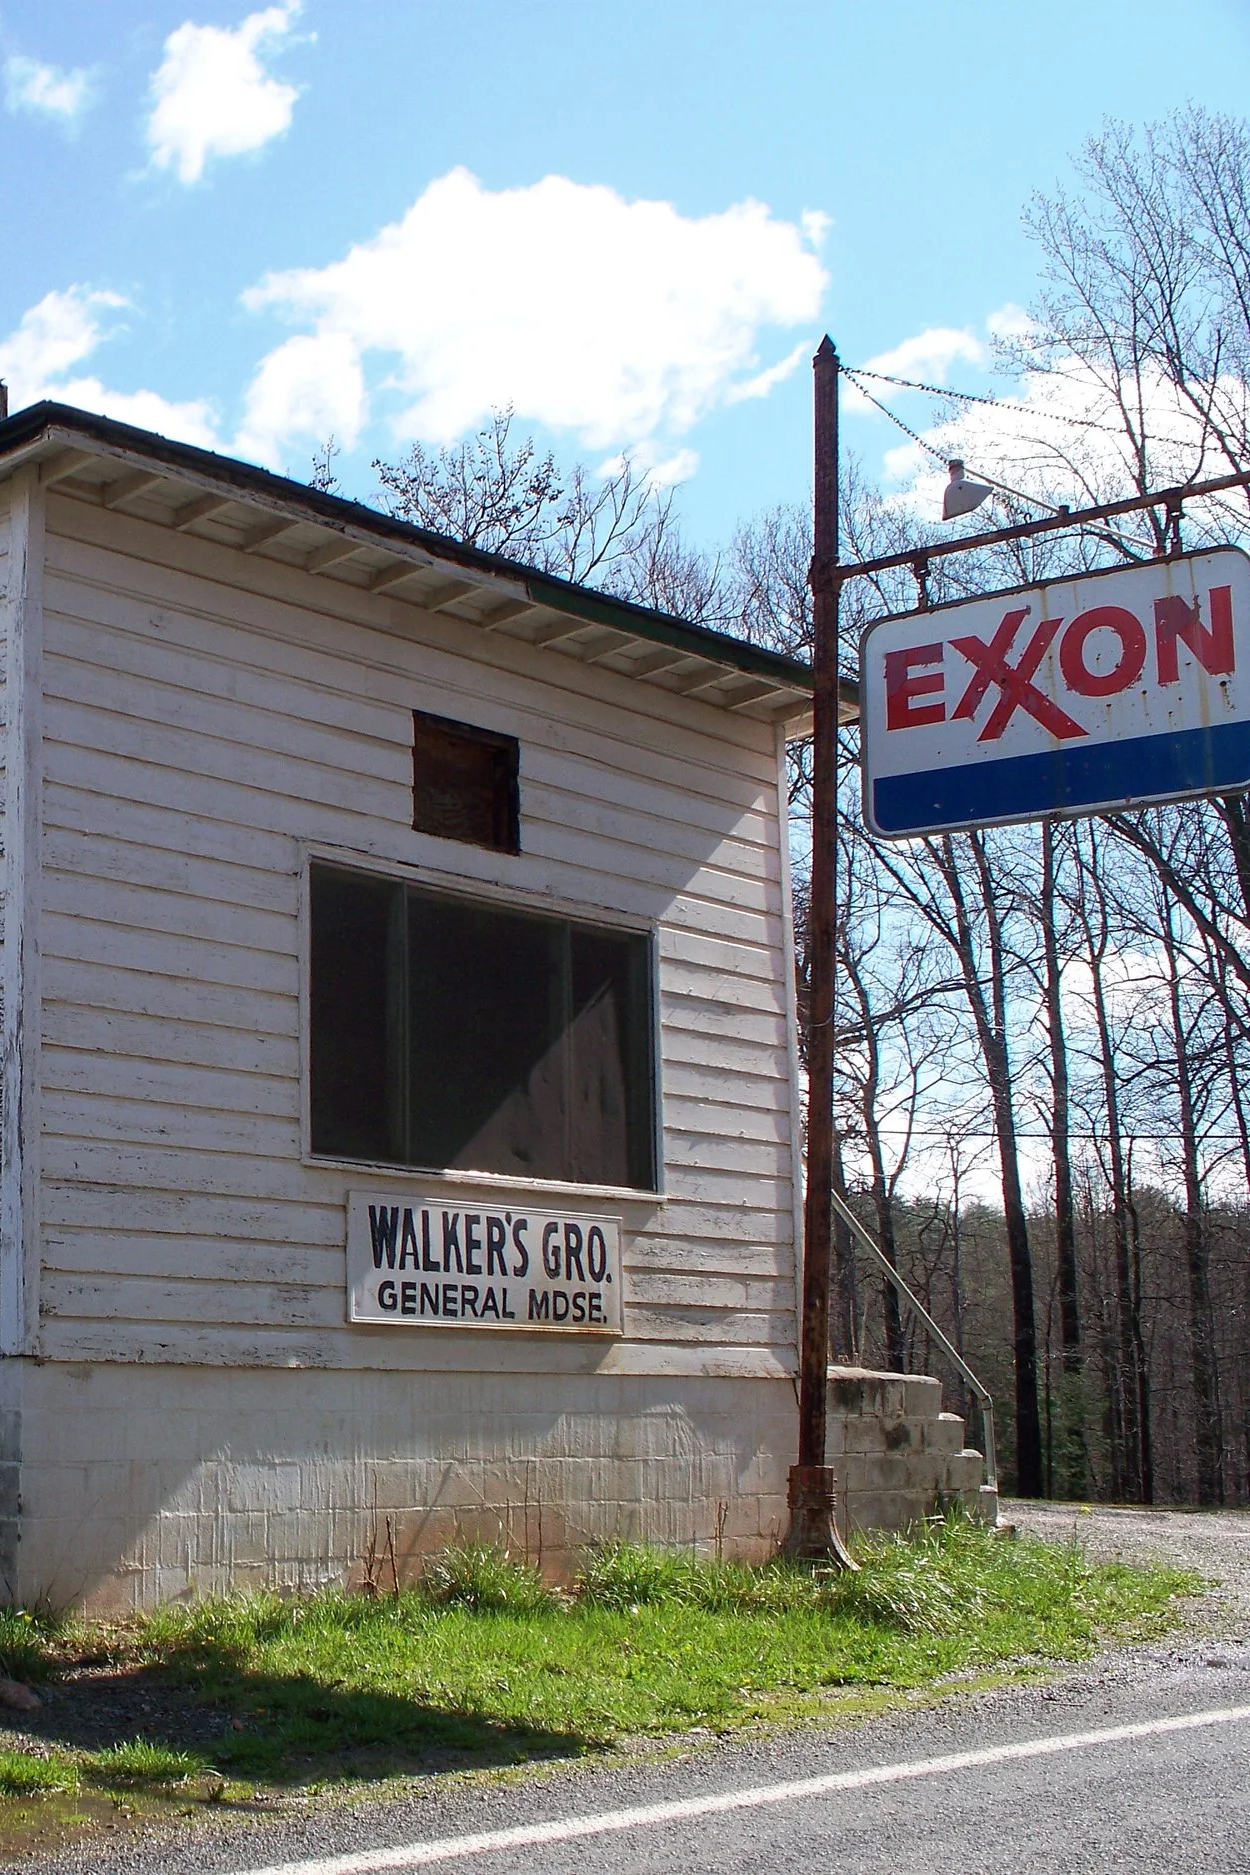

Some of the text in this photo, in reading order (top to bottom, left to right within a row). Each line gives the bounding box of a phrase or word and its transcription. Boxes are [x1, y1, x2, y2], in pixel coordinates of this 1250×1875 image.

[883, 585, 1236, 742] EXXON
[368, 1204, 613, 1284] WALKER'S GRO.
[377, 1280, 608, 1324] GENERAL MDSE.
